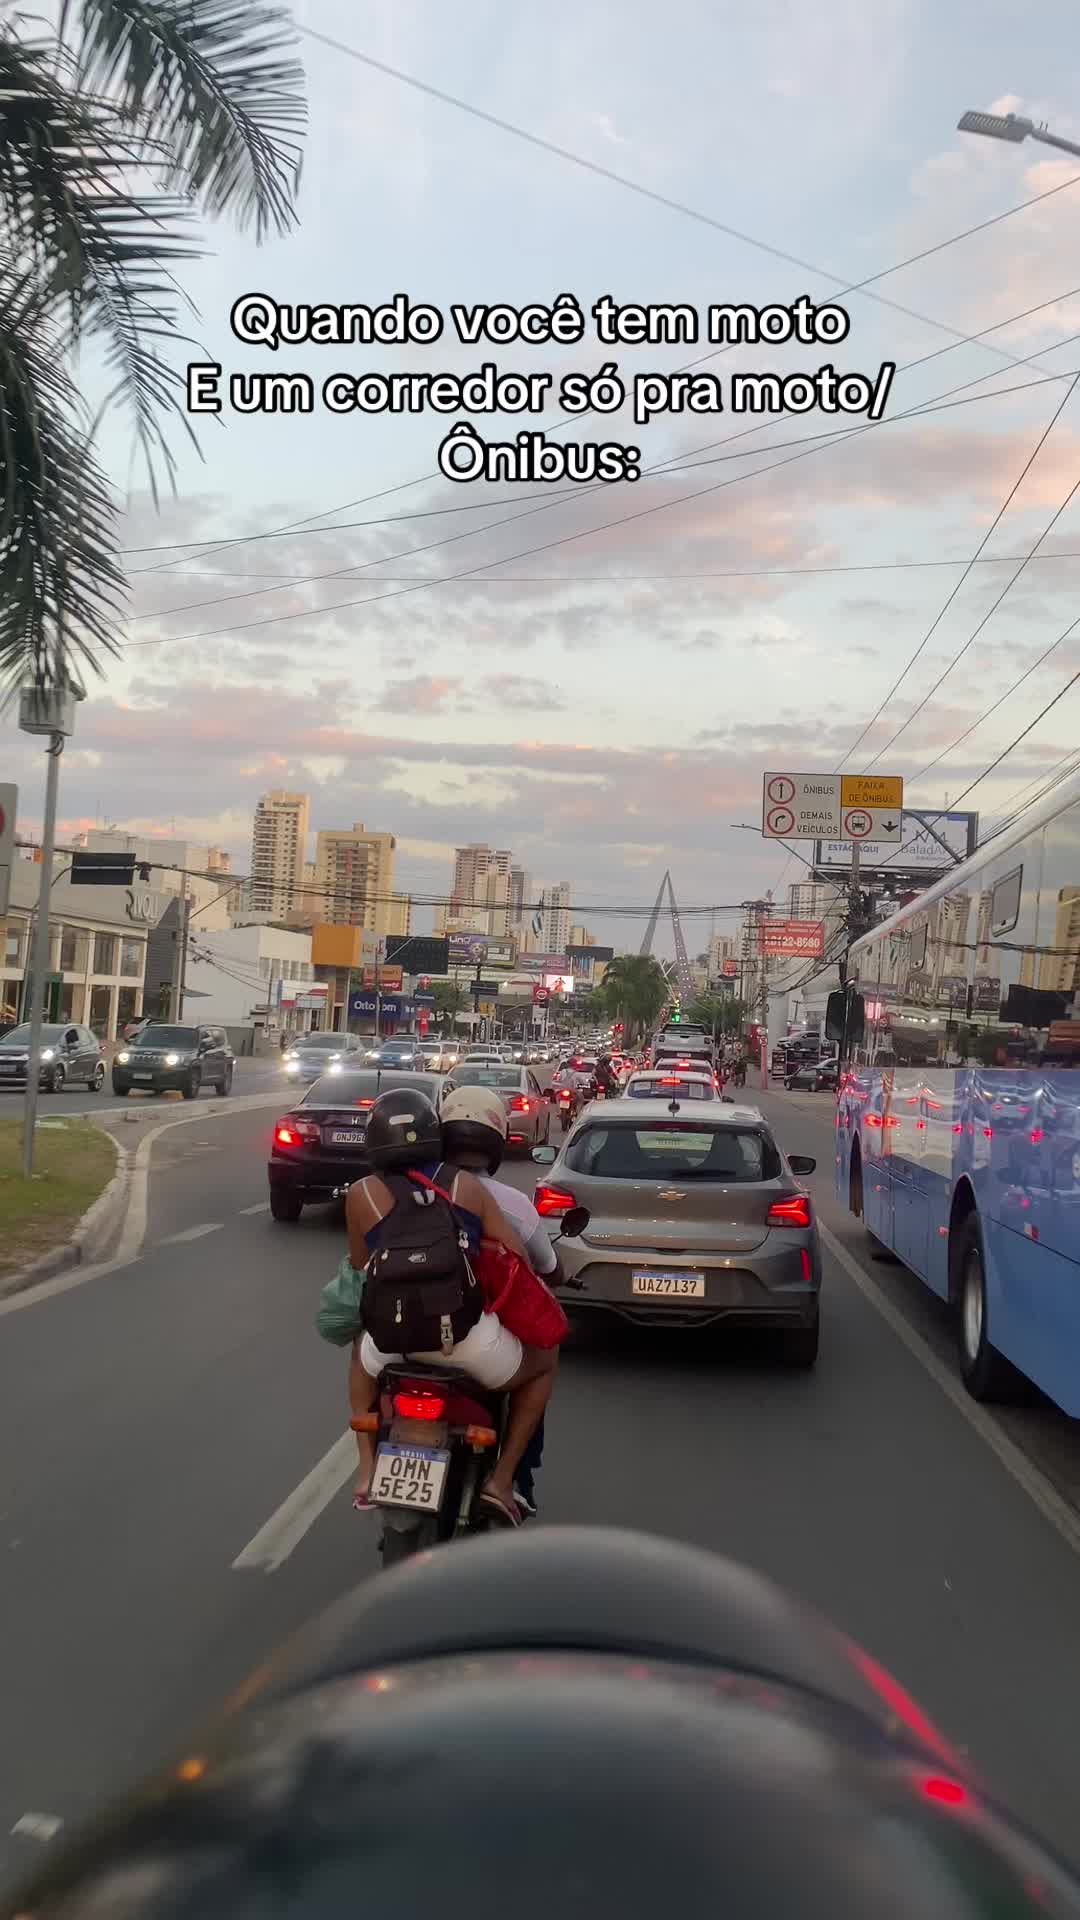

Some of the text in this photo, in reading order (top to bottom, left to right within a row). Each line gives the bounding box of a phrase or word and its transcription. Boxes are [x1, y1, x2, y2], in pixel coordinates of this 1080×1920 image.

[803, 784, 835, 795] ÔNIBUS
[856, 781, 885, 790] FAIXA
[848, 792, 896, 803] DE ÔNIBUS
[800, 811, 833, 820] DEMAIS
[797, 822, 839, 834] VEÍCULOS
[353, 1000, 397, 1012] Ortoom
[638, 1278, 697, 1294] UAZ7137
[390, 1457, 431, 1480] OMN
[378, 1476, 434, 1503] 5E25
